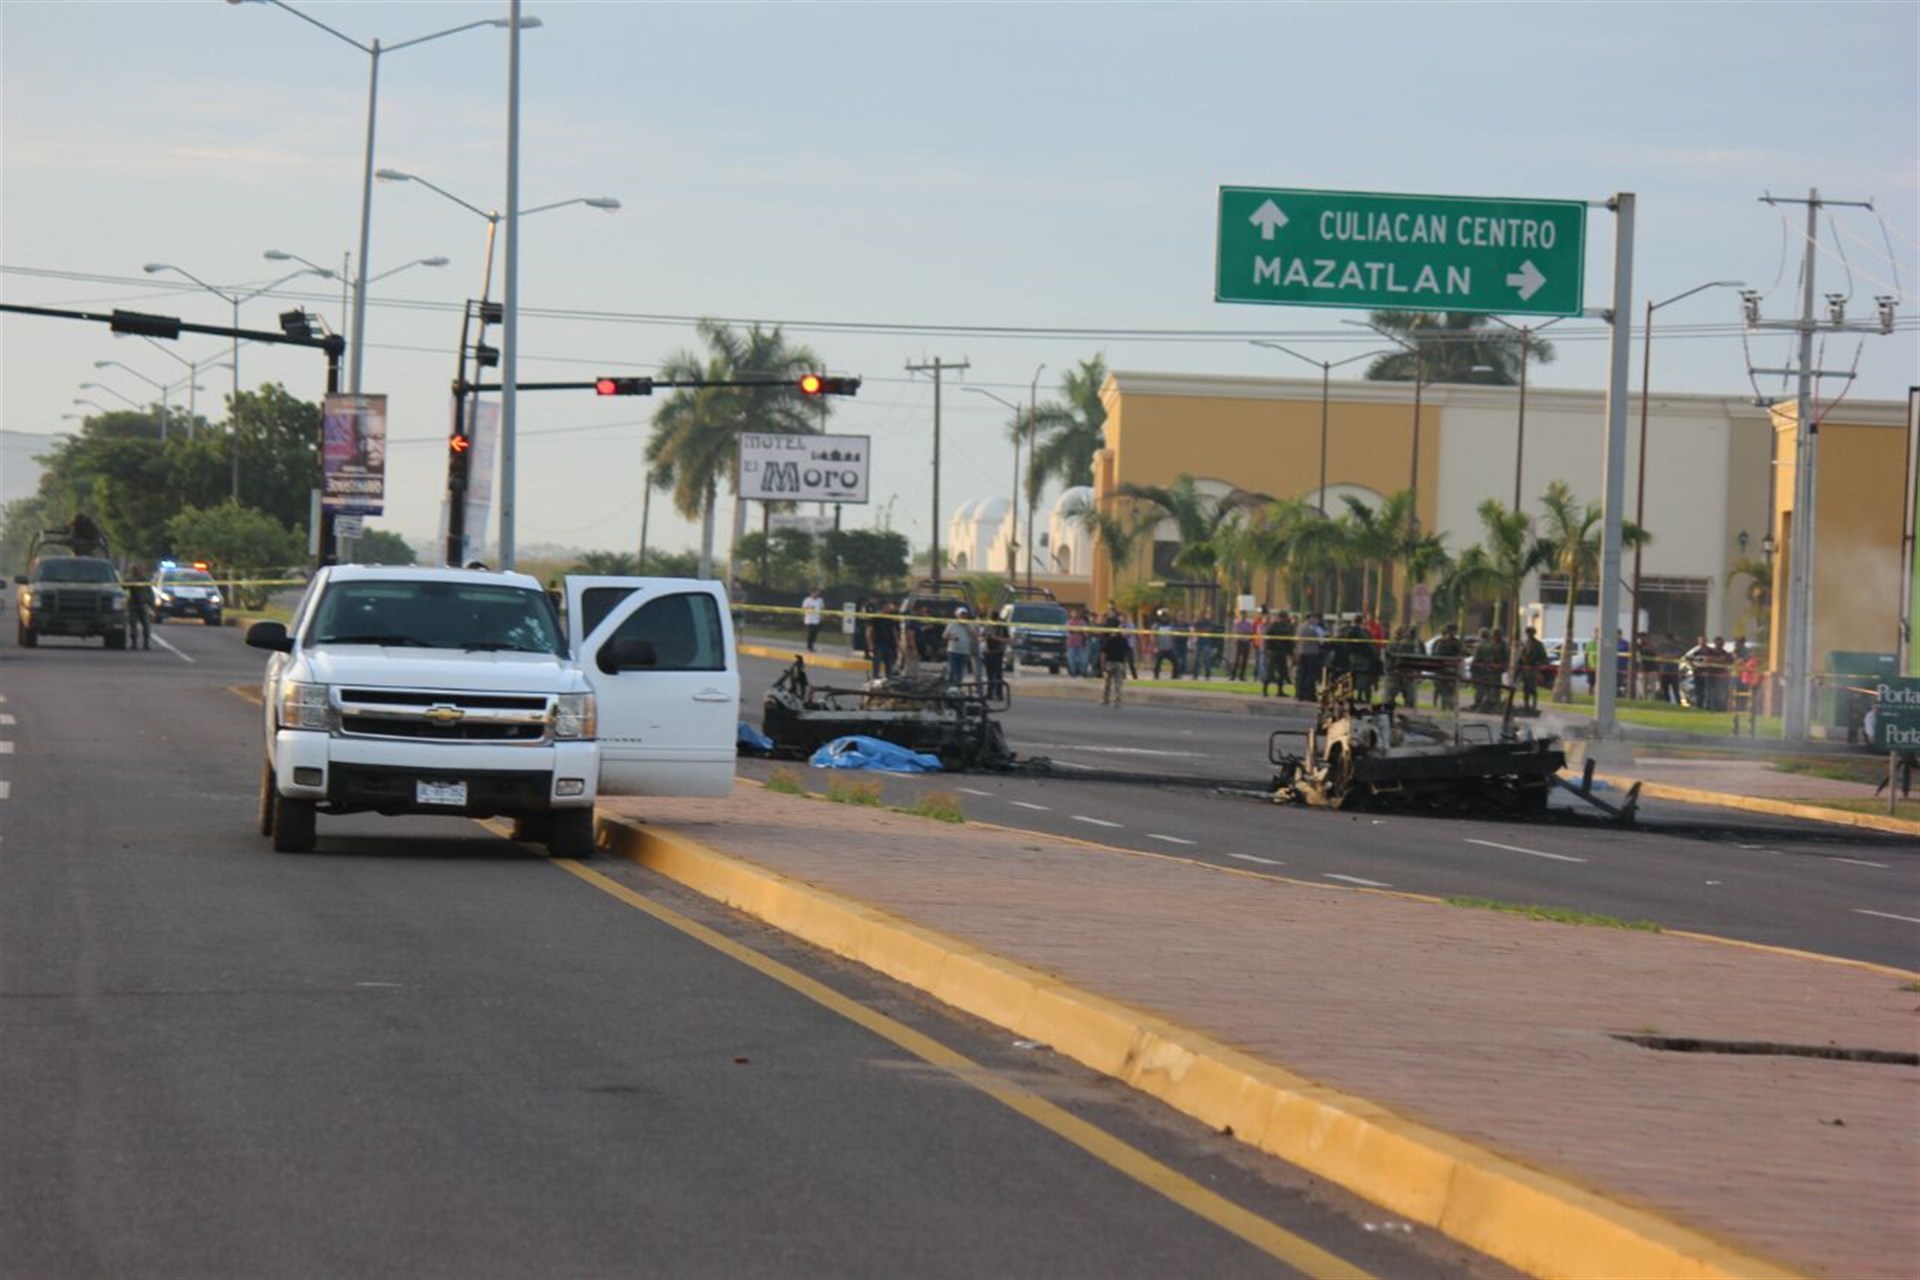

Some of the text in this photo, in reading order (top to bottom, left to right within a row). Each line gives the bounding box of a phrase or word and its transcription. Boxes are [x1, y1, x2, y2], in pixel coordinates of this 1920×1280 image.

[1319, 211, 1556, 249] CULIACAN CENTRO
[1253, 255, 1471, 295] MAZATLAN
[744, 436, 806, 450] MOTEL
